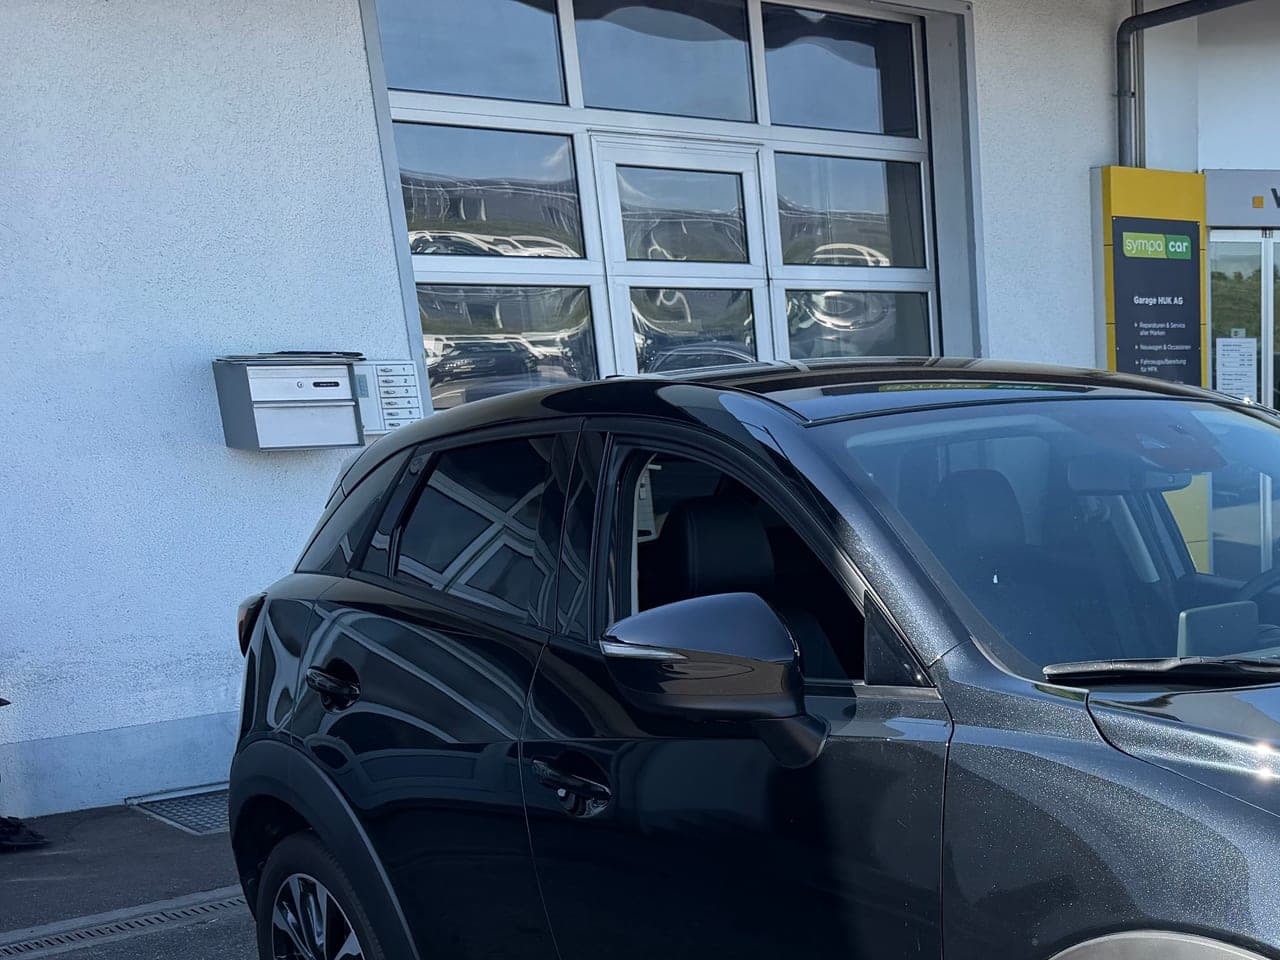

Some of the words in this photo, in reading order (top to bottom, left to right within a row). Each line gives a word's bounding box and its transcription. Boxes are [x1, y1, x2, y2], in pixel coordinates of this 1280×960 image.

[1126, 239, 1163, 255] sympa
[1168, 241, 1188, 252] car
[1133, 296, 1157, 305] Garage
[1158, 297, 1172, 305] HUK
[1173, 297, 1184, 305] AG
